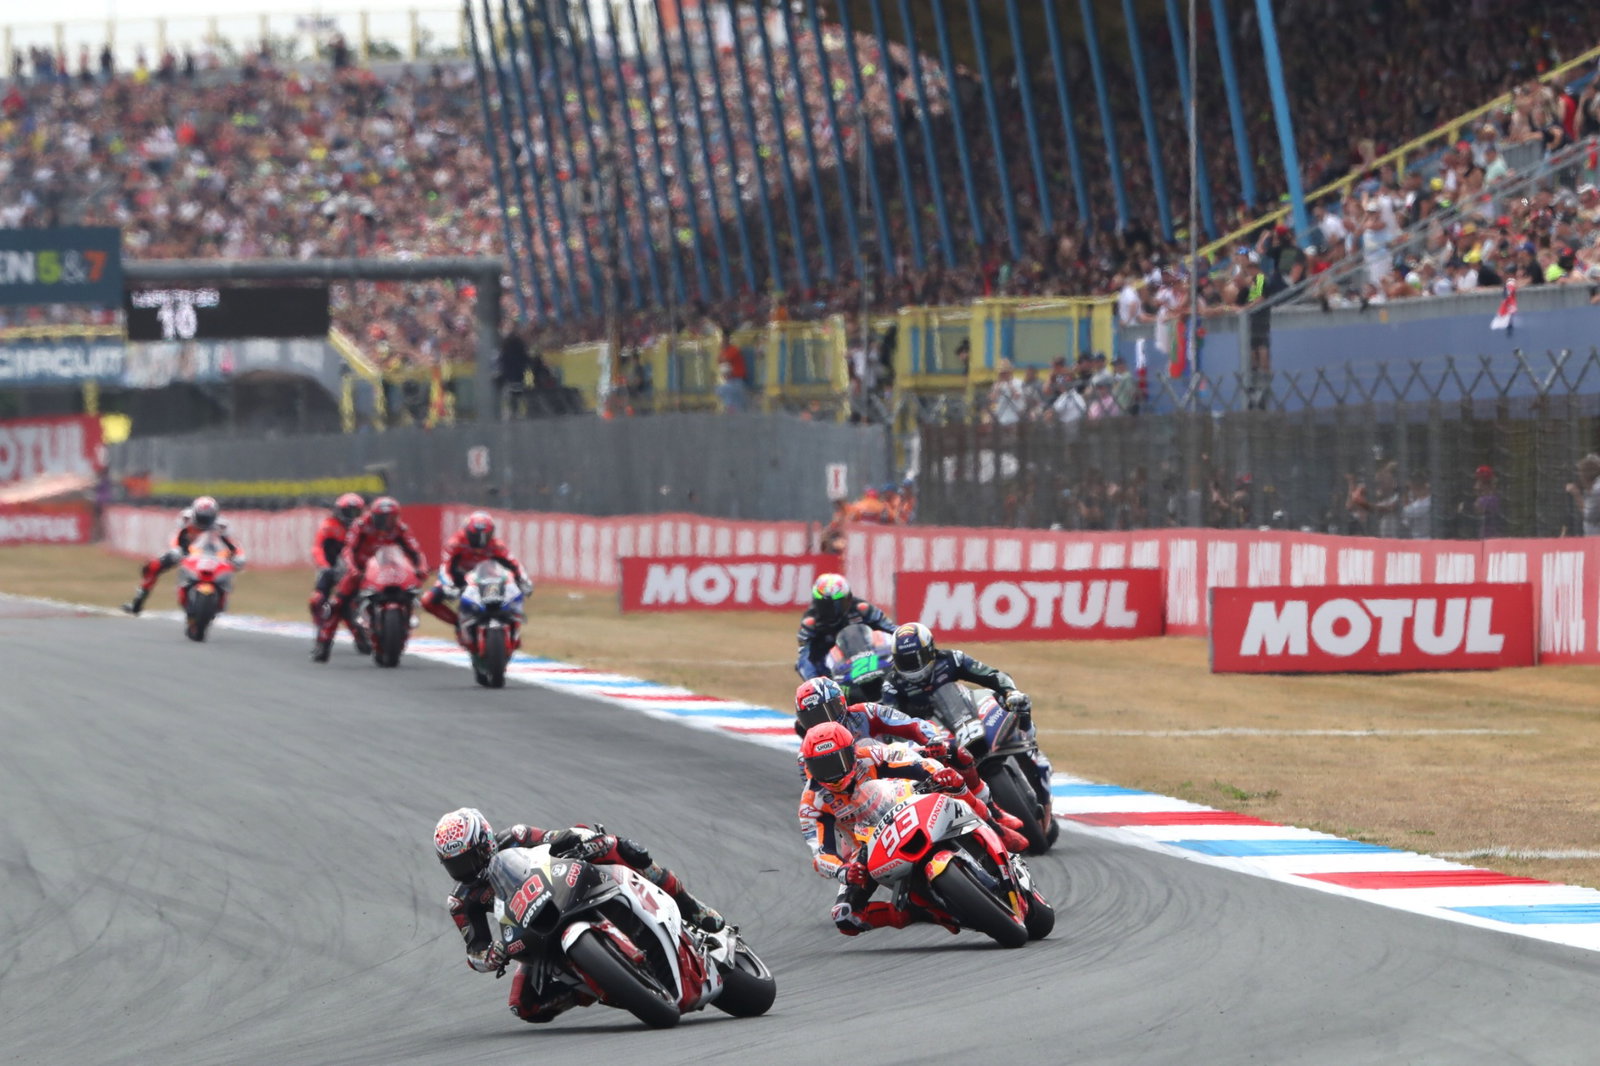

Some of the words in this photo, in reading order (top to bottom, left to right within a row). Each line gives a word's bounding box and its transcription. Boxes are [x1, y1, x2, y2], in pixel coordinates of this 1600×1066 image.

[641, 562, 815, 606] MOTUL
[919, 580, 1138, 630] MOTUL
[1239, 598, 1505, 656] MOTUL
[850, 655, 879, 679] 21
[956, 720, 985, 747] 25
[880, 804, 920, 858] 93
[927, 795, 947, 830] HONDA
[565, 862, 582, 888] GIVI
[509, 873, 545, 923] 30
[522, 890, 552, 929] CUSTOM
